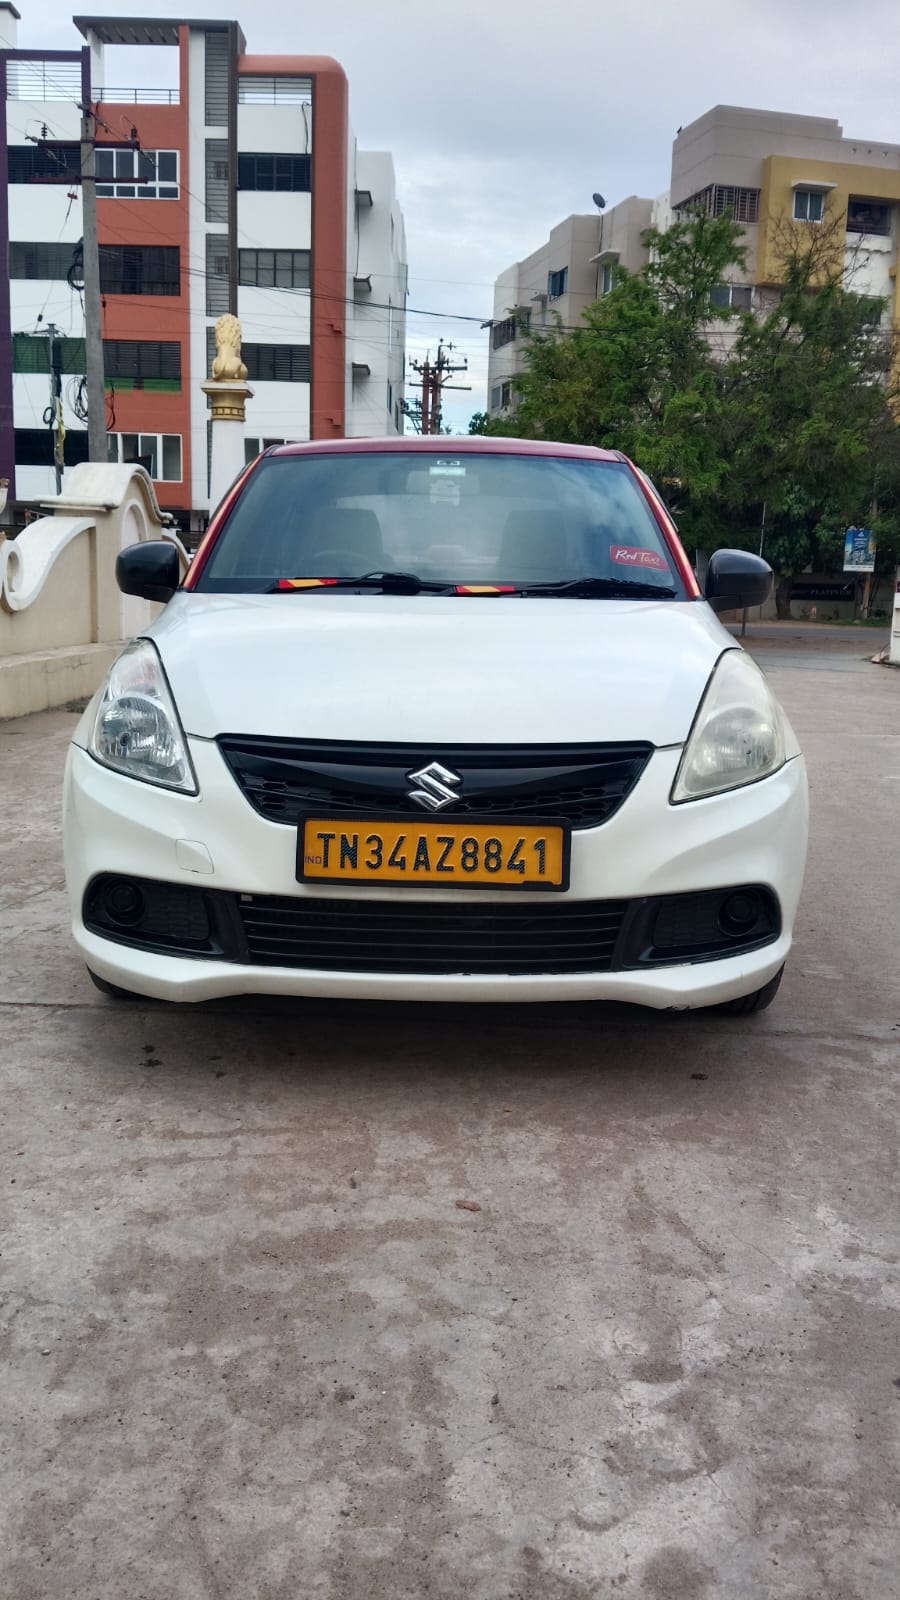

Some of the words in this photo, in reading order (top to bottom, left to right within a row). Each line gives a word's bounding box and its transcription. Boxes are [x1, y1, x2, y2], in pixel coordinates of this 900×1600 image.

[615, 549, 638, 560] Red
[317, 832, 547, 874] TN34AZ8841
[304, 855, 322, 865] IND
